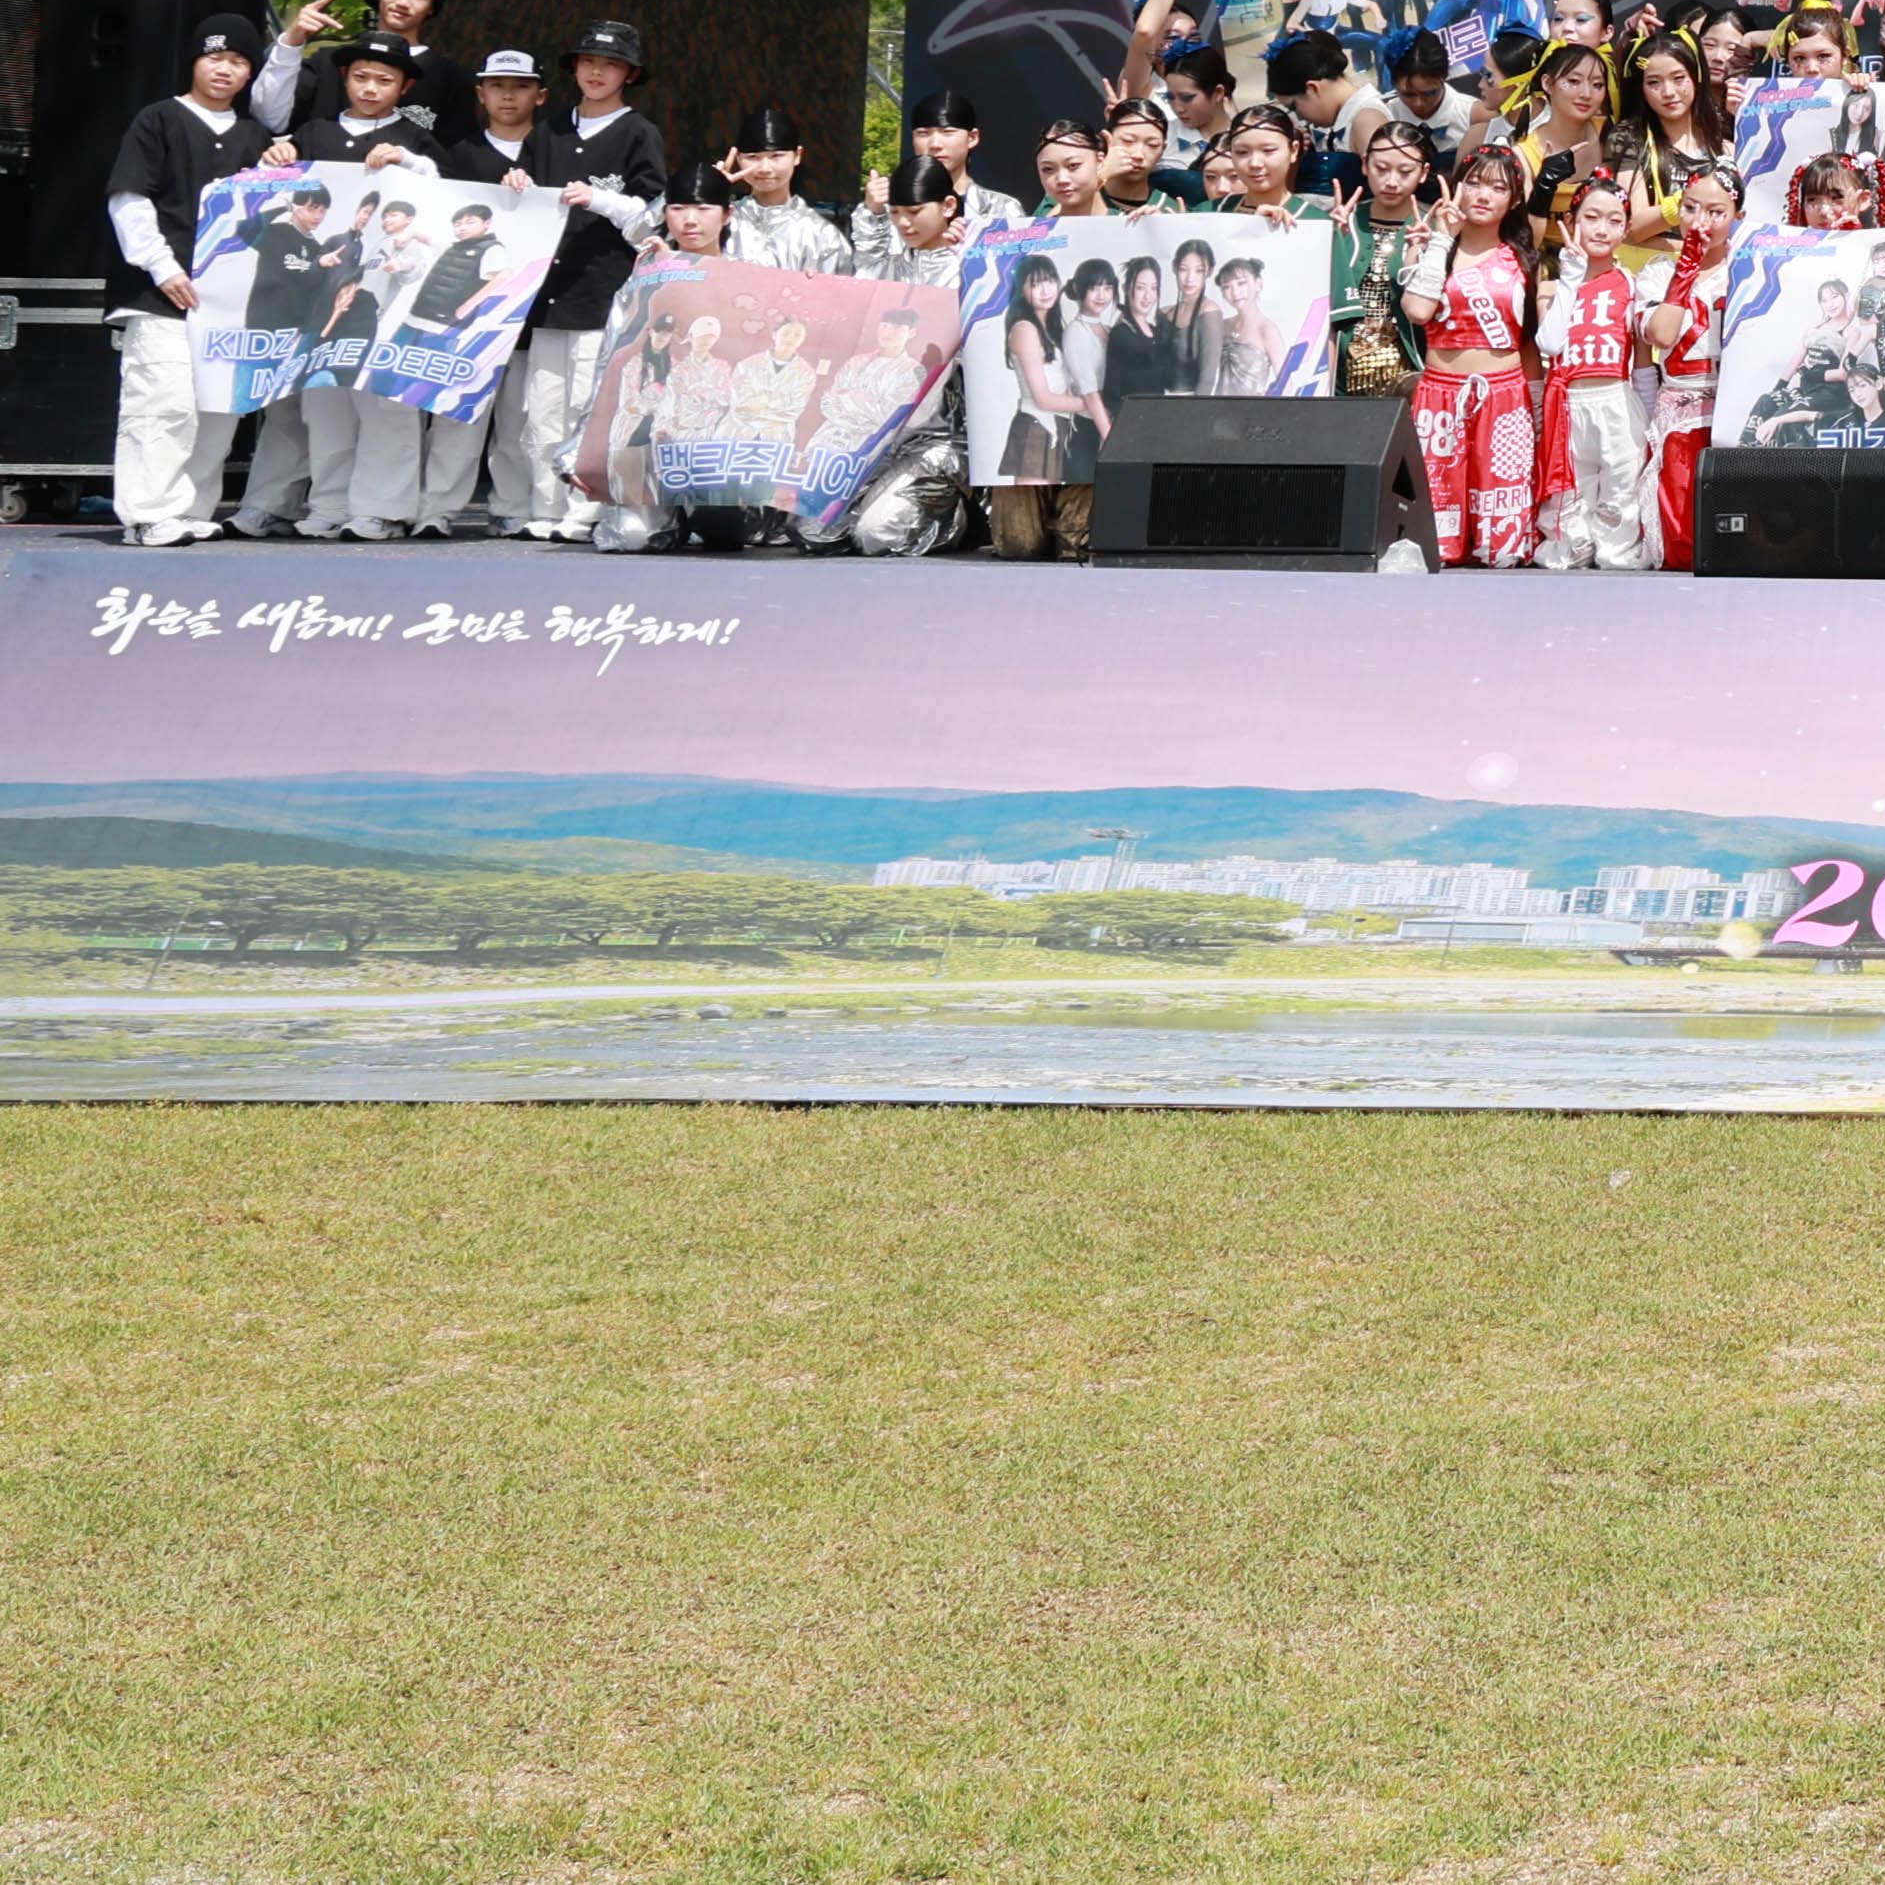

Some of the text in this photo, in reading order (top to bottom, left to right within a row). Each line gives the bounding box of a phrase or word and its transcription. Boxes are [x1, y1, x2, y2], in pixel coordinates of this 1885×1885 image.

[1018, 234, 1068, 254] STAGE
[1453, 267, 1513, 350] Dream
[204, 327, 298, 361] KIDZ
[306, 338, 369, 373] THE
[364, 341, 476, 386] DEEP
[657, 440, 866, 499] 뱅크주니어
[91, 586, 740, 678] 화순을 새롭게! 군민을 행복하게!
